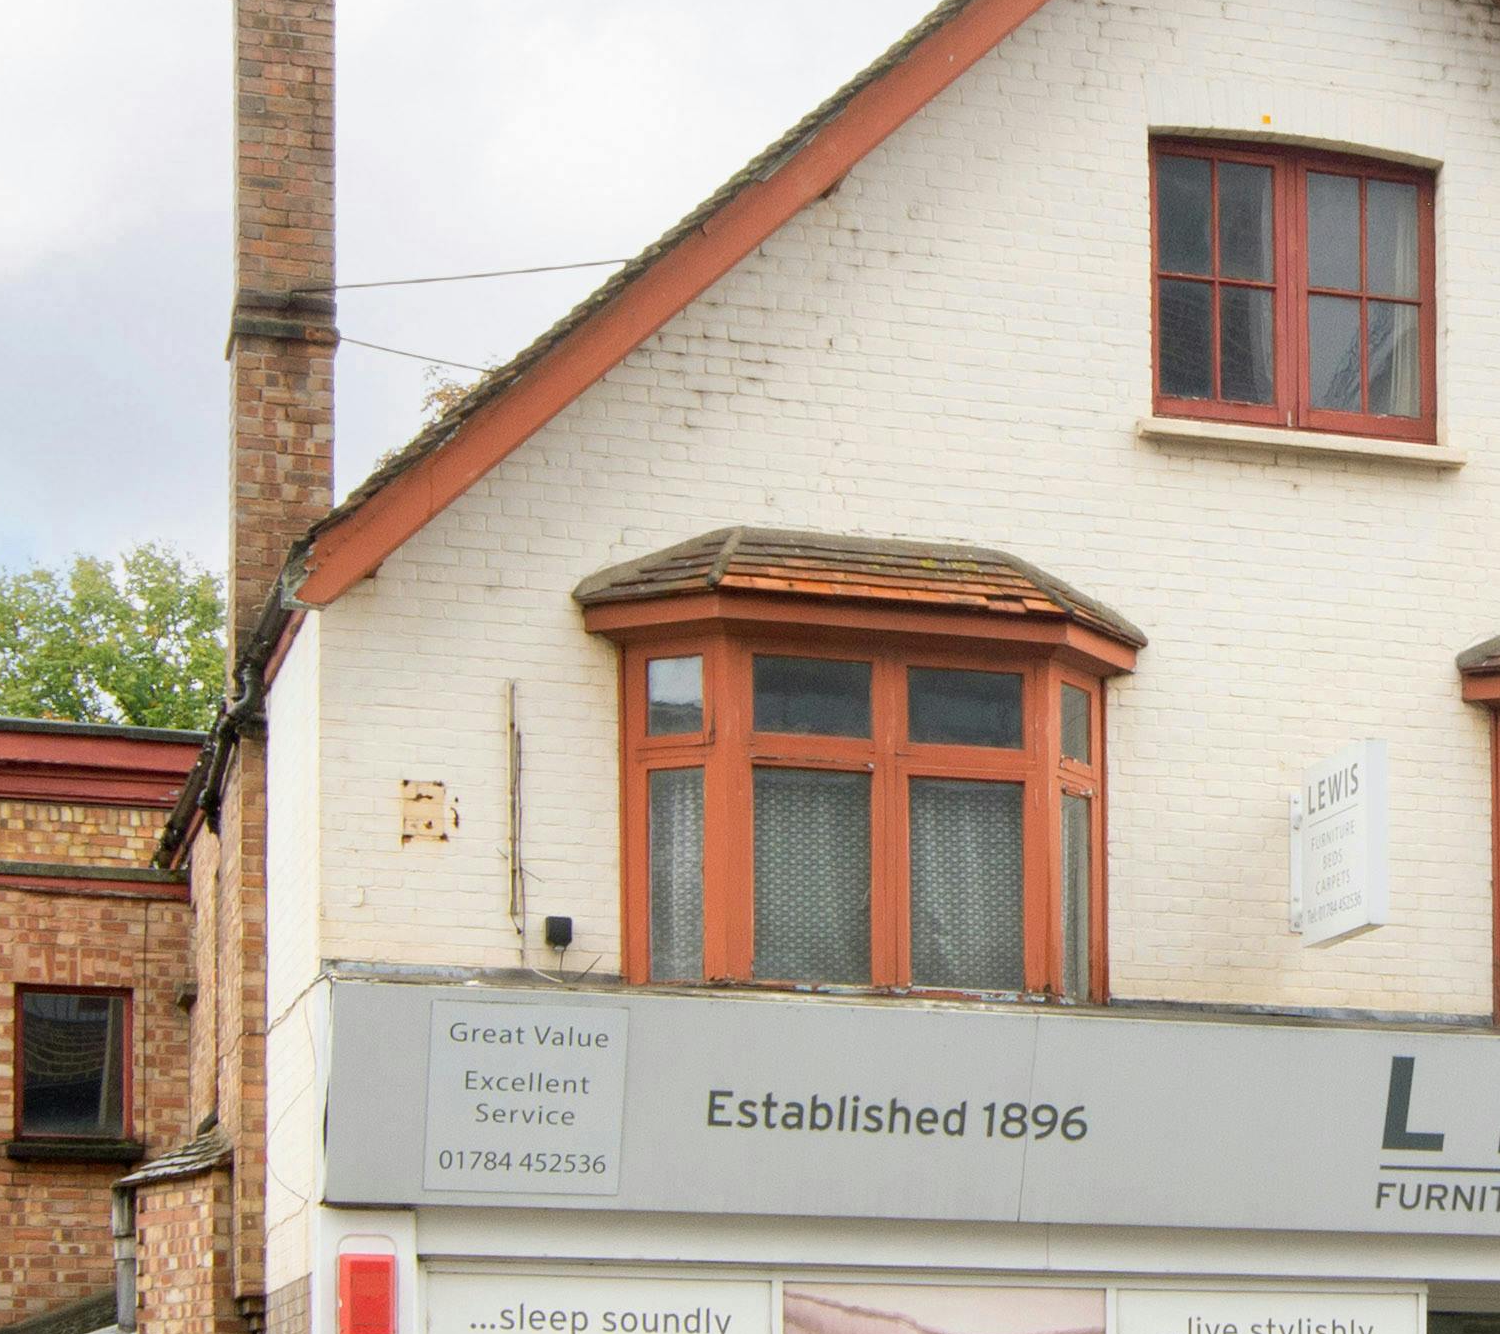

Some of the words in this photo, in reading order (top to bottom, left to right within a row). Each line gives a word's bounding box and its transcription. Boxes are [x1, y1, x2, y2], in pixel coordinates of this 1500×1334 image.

[1308, 763, 1359, 815] LEWIS
[1311, 819, 1356, 851] FURNITURE
[1322, 848, 1344, 870] BEDS
[1315, 869, 1351, 896] CARPETS
[449, 1021, 524, 1047] Great
[534, 1024, 610, 1049] Value
[464, 1070, 590, 1095] Excellent
[475, 1103, 576, 1127] Service
[708, 1090, 966, 1138] Established
[984, 1103, 1089, 1142] 1896
[438, 1149, 512, 1172] 01784
[519, 1152, 607, 1176] 452536
